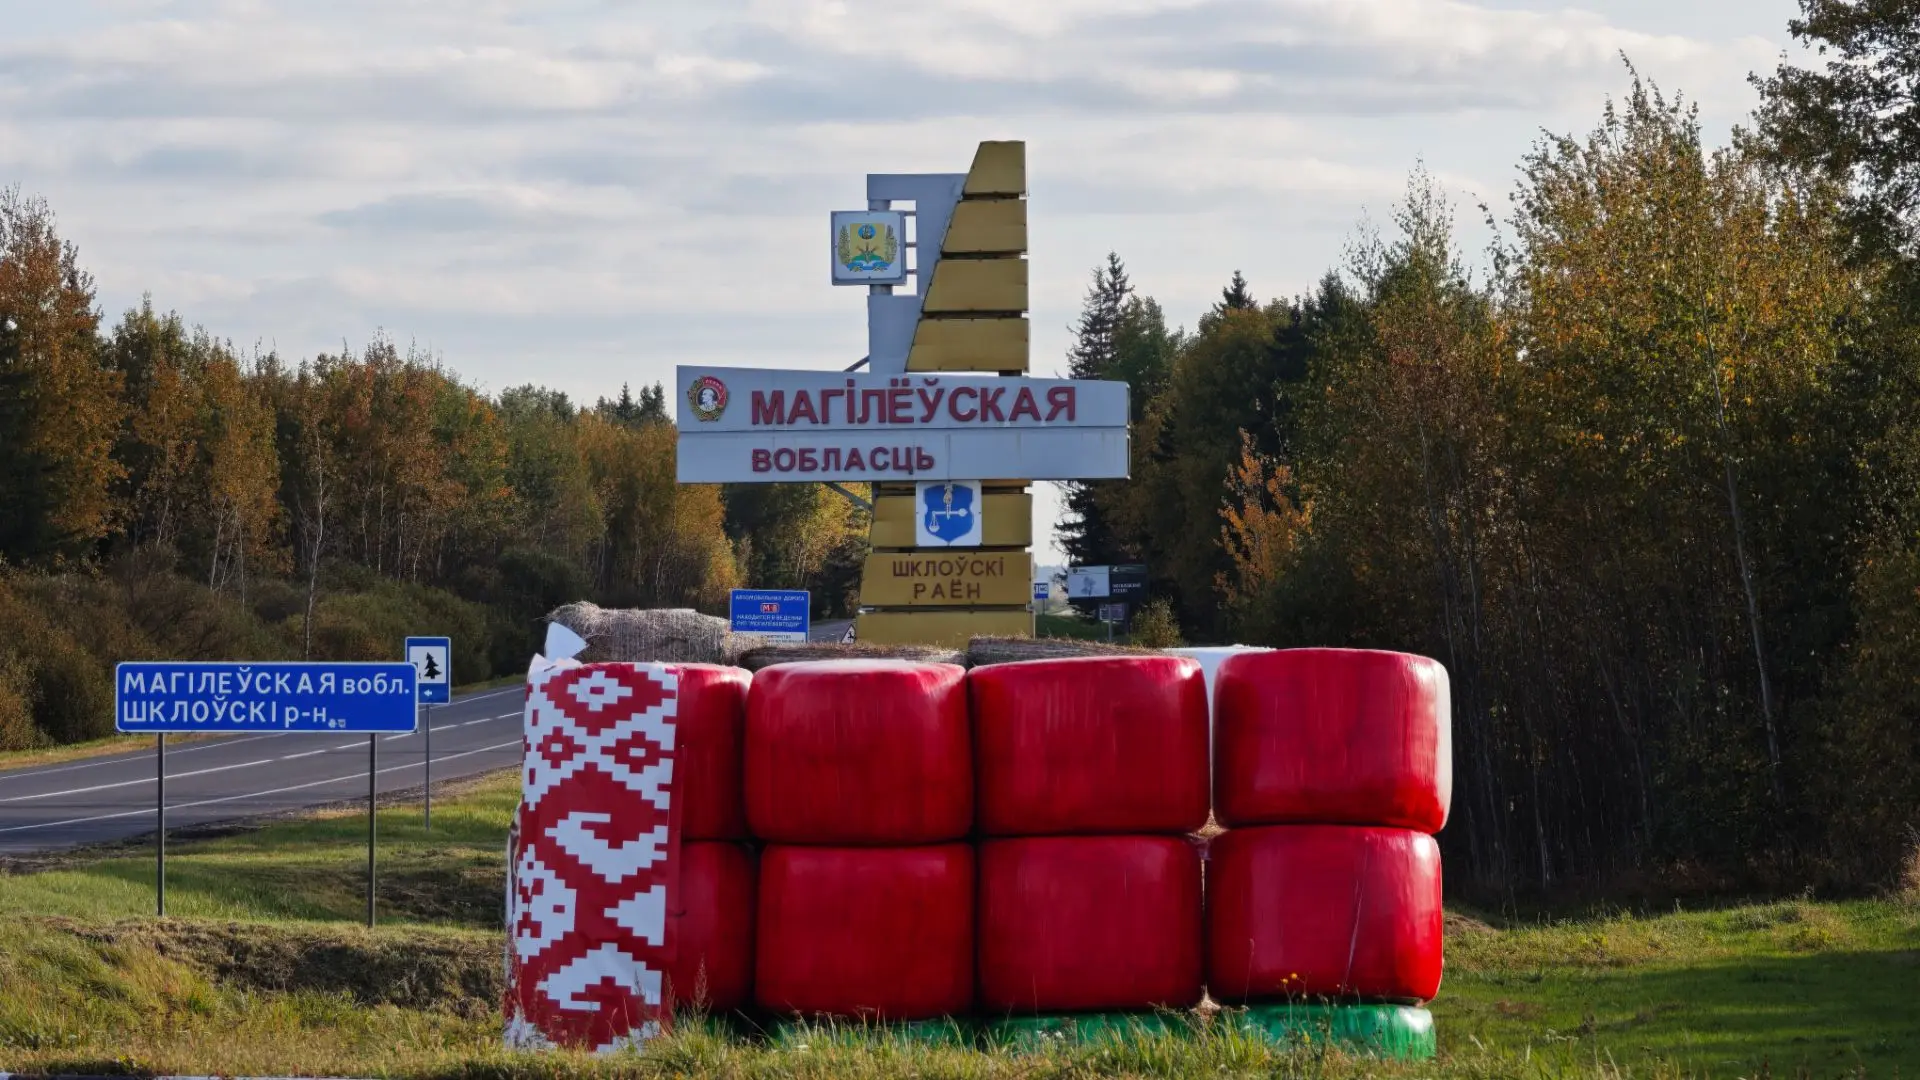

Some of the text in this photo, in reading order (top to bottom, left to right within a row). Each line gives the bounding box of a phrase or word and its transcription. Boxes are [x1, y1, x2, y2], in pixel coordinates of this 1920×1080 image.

[751, 378, 1076, 425] МАГІЛЁЎСКАЯ
[752, 446, 935, 475] ВОБЛАСЦЬ
[892, 556, 1004, 577] ШКЛОЎСКІ
[913, 579, 981, 599] РАЁН
[123, 666, 410, 694] МАГІЛЕЎСКАЯ вобл.
[123, 695, 277, 723] ШКЛОЎСКІ
